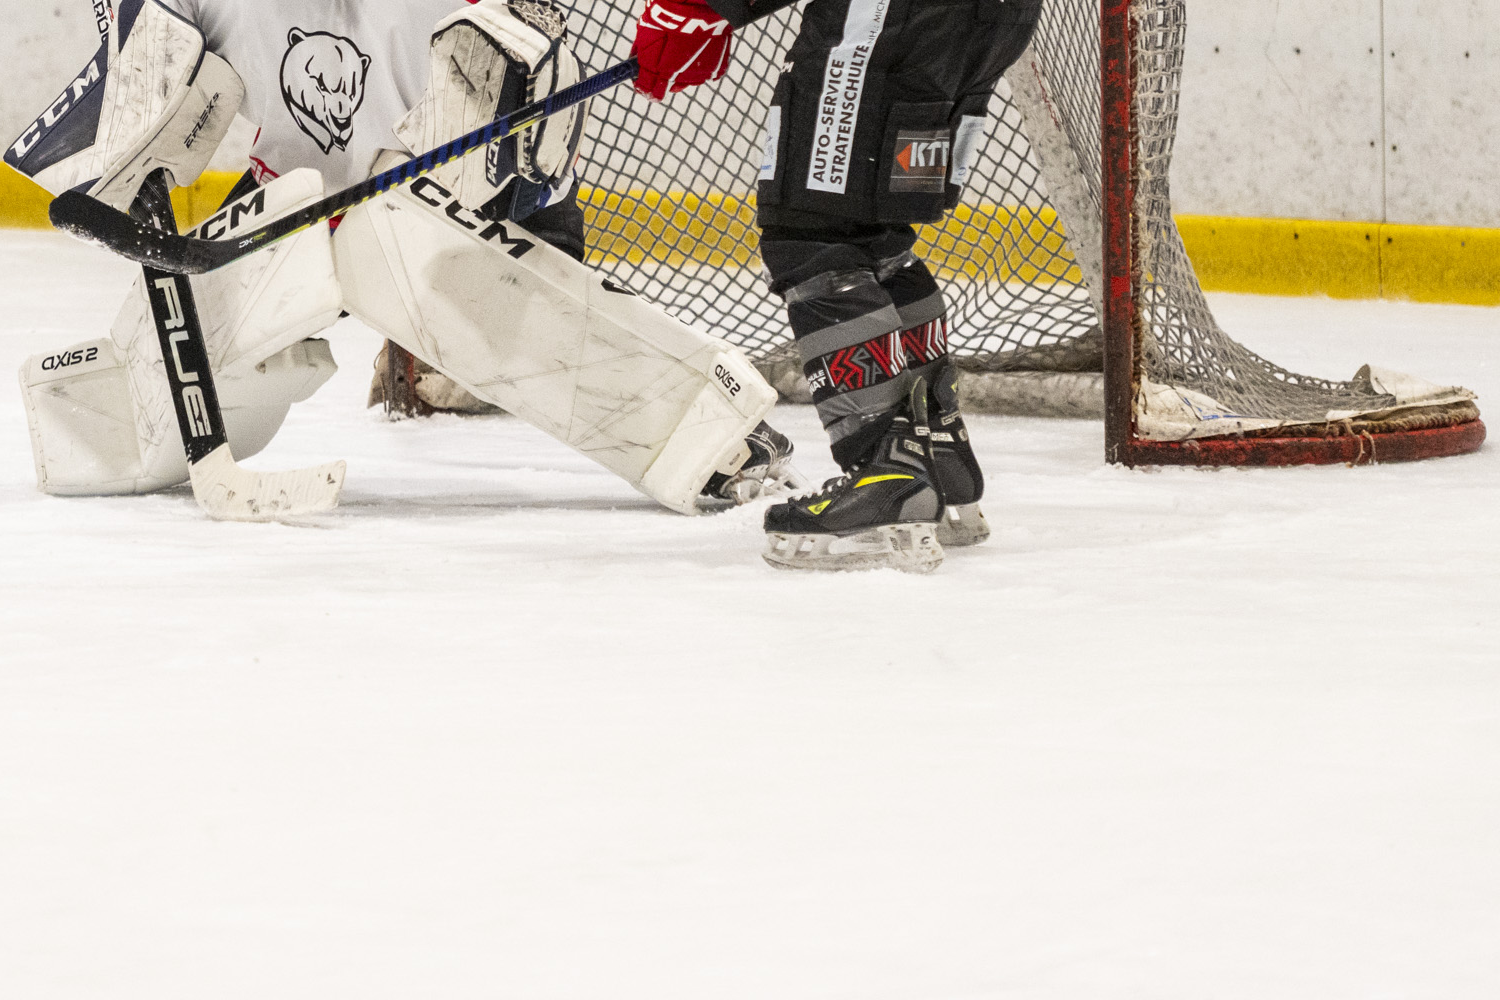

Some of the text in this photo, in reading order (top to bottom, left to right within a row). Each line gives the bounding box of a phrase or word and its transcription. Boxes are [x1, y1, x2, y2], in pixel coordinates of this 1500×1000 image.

[9, 59, 100, 159] CCM
[812, 58, 846, 184] AUTO-SERVICE
[829, 44, 871, 186] STRATENSCHULTE
[181, 187, 266, 241] CM
[409, 176, 537, 260] CCM
[84, 347, 99, 362] 2
[729, 382, 741, 397] 2
